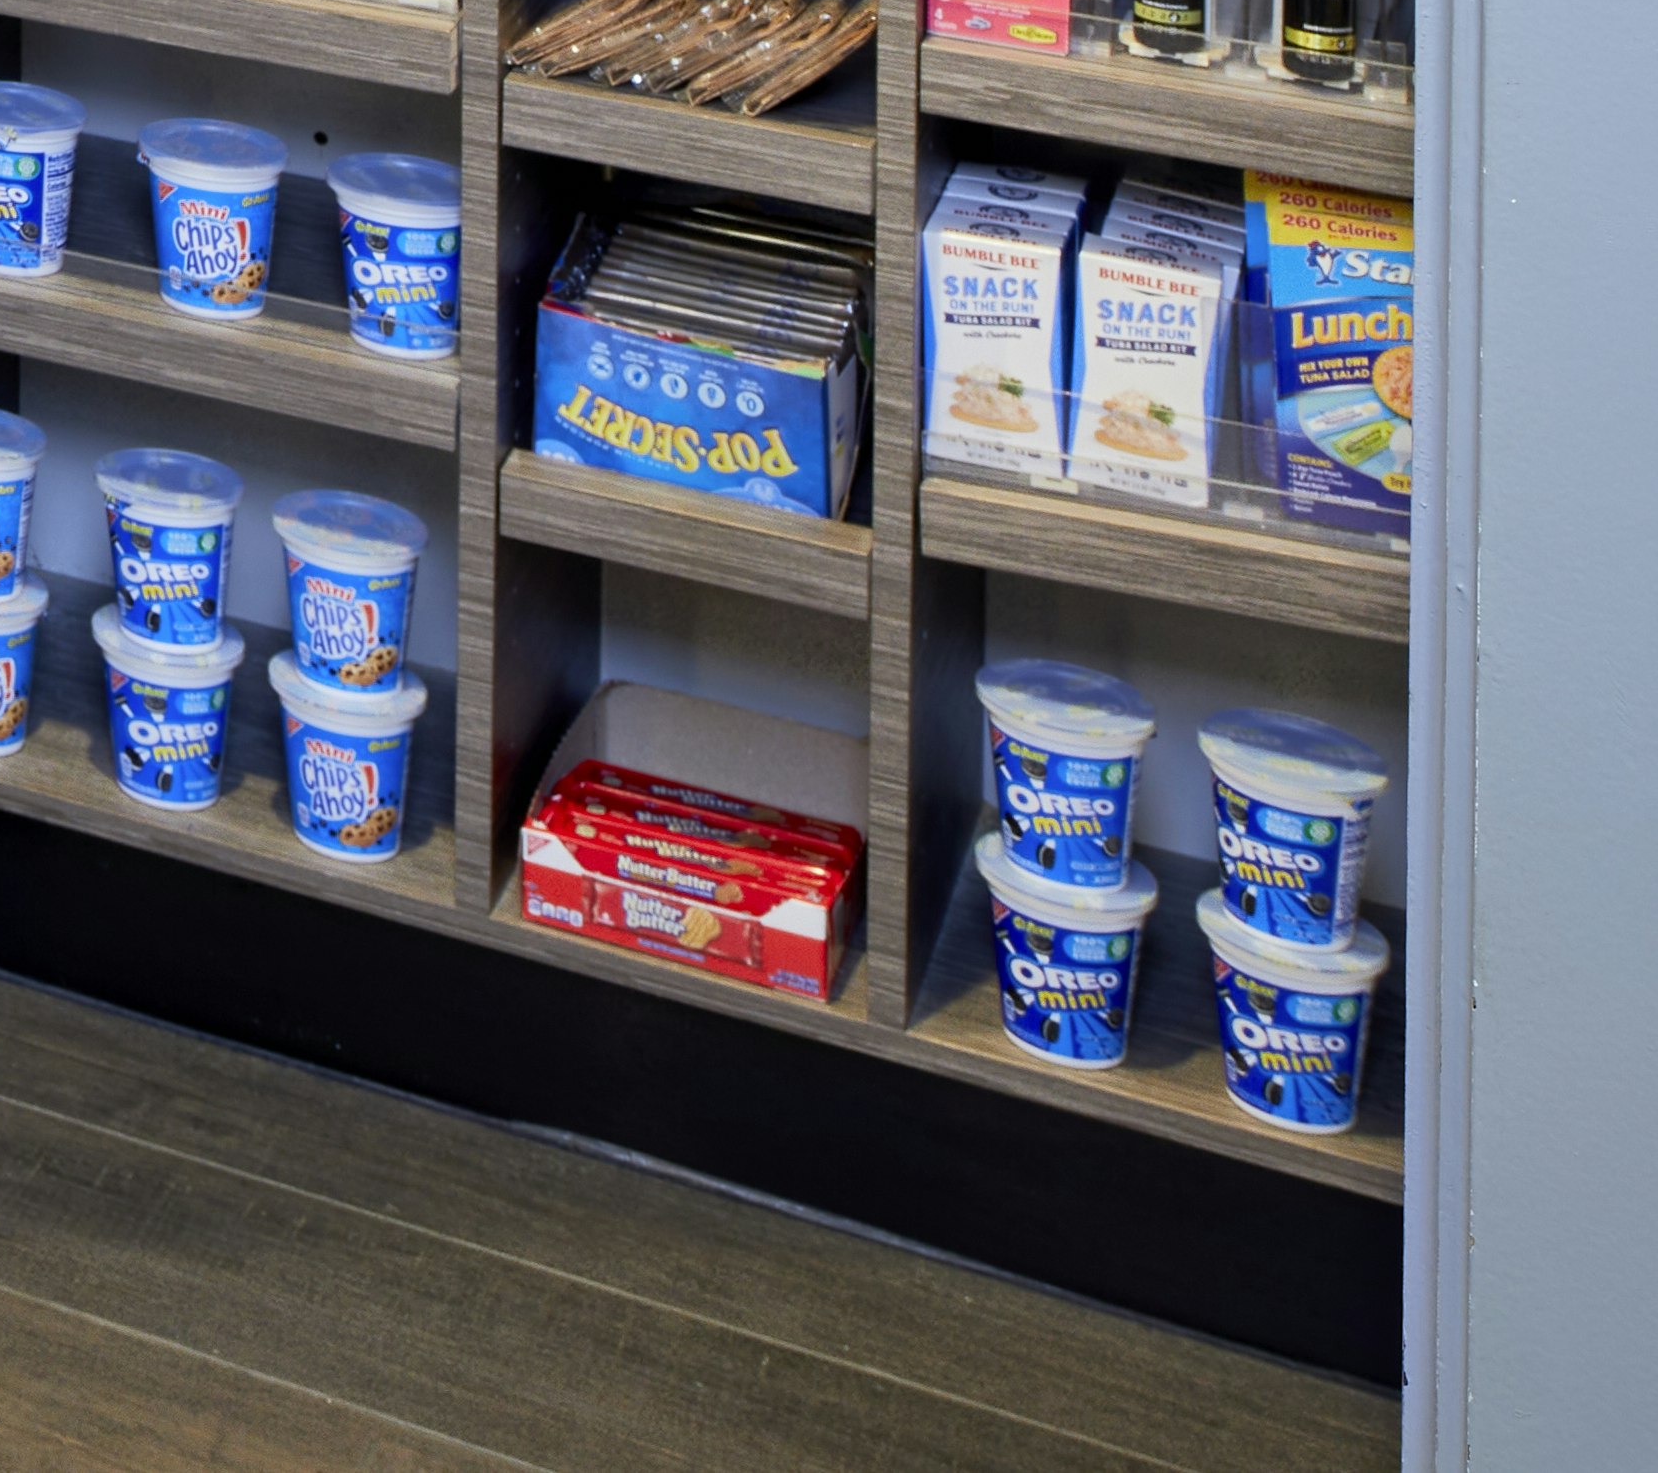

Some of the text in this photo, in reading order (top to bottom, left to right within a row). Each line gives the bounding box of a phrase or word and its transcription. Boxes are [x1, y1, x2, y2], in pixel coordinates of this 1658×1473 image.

[179, 199, 228, 221] Mini
[1280, 192, 1393, 218] 260 Calories
[175, 219, 237, 255] Chips
[1283, 213, 1398, 241] 260 Calories
[942, 243, 1040, 270] BUMBLE BEE
[353, 262, 448, 285] OREO
[1098, 266, 1199, 297] BUMBLE BEE
[376, 284, 438, 304] mini
[942, 275, 1040, 301] SNACK
[949, 299, 1034, 315] ON THE RUN!
[1096, 299, 1197, 327] SNACK
[952, 314, 1033, 328] TUNA SALAD KIT
[1102, 323, 1191, 341] ON THE RUN!
[1291, 303, 1413, 349] Lunch
[1346, 357, 1369, 367] OWN
[1299, 369, 1370, 384] TUNA SALAD
[1006, 785, 1115, 816] OREO
[1033, 814, 1102, 836] mini
[617, 854, 717, 896] Nutter Butter
[622, 891, 683, 919] Nutter
[626, 910, 686, 937] Butter
[1232, 1017, 1347, 1054] OREO
[1259, 1050, 1334, 1073] mini
